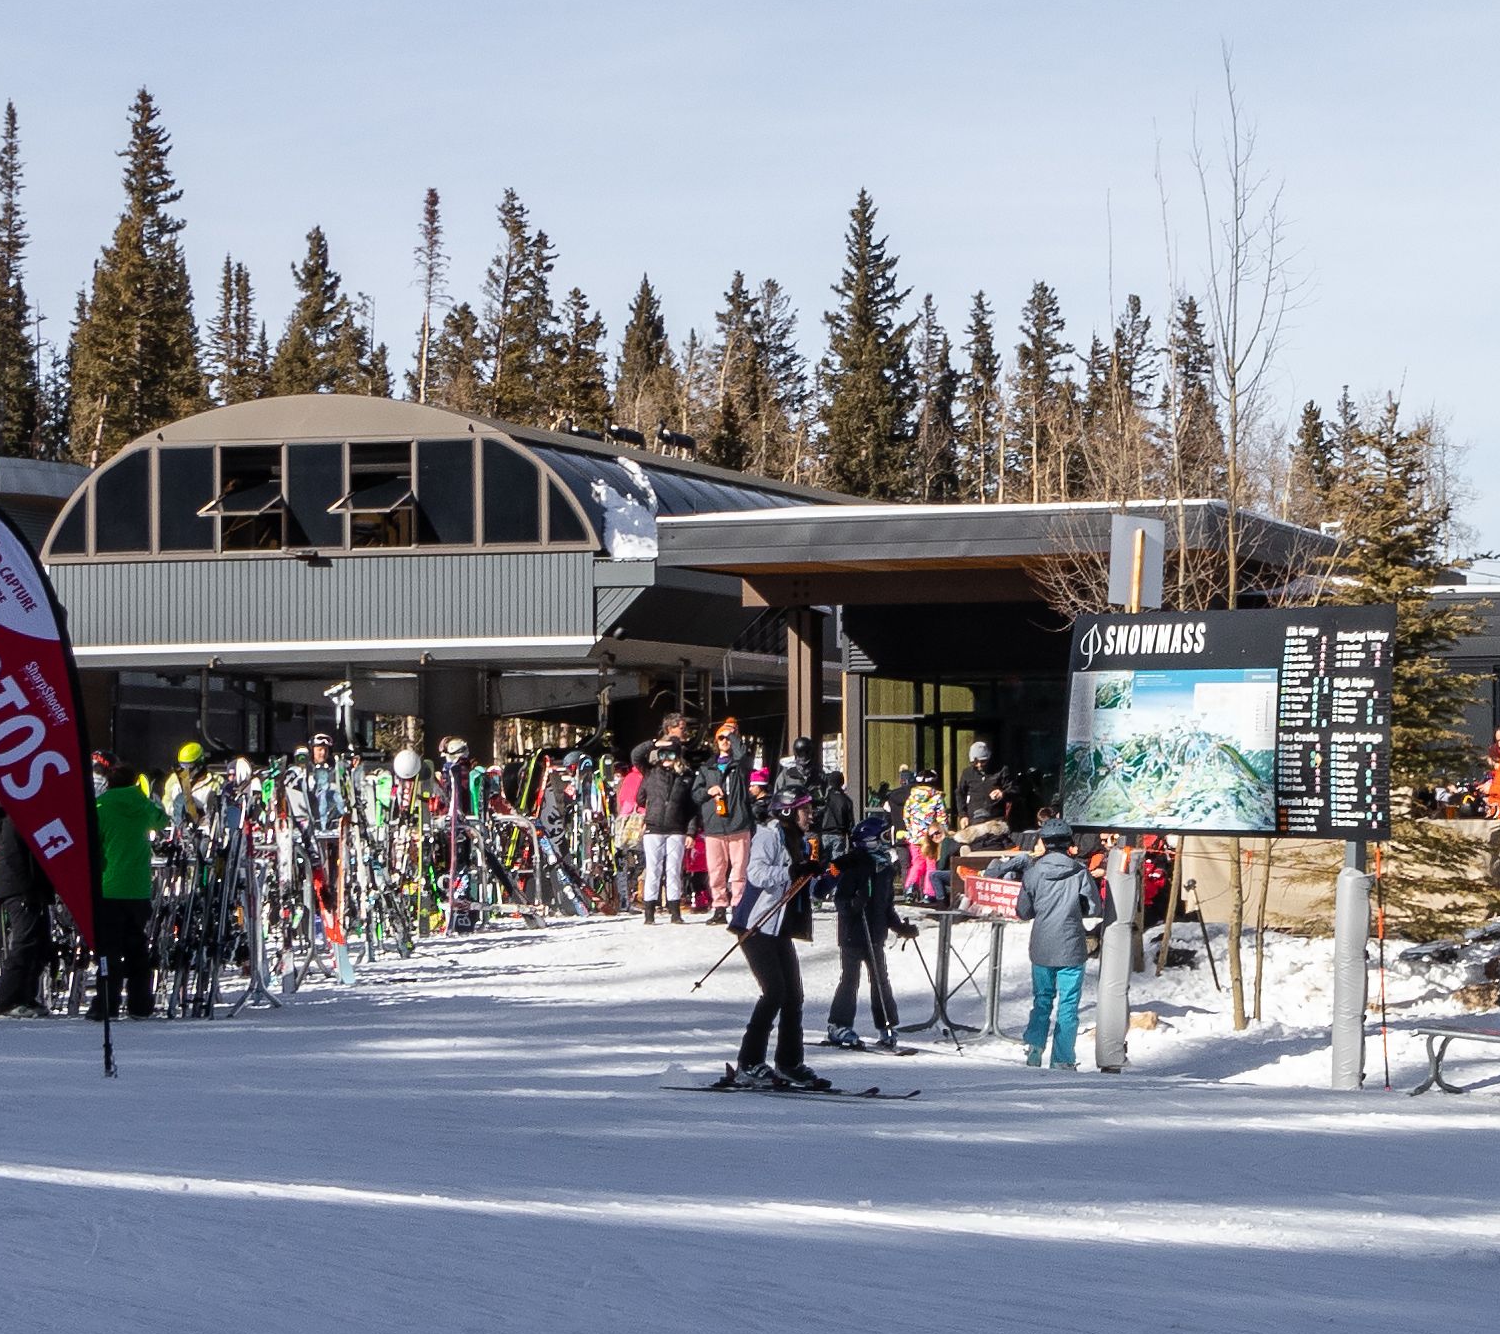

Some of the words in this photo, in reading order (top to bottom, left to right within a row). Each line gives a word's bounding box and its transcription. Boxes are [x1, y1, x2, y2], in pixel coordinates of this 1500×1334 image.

[0, 566, 38, 614] CAPTURE
[1103, 622, 1207, 656] SNOWMASS
[25, 660, 70, 726] SharpShooter
[1279, 732, 1293, 741] Two
[1294, 732, 1319, 742] Creeks
[1278, 797, 1302, 806] Terrain
[1303, 797, 1324, 807] Parks
